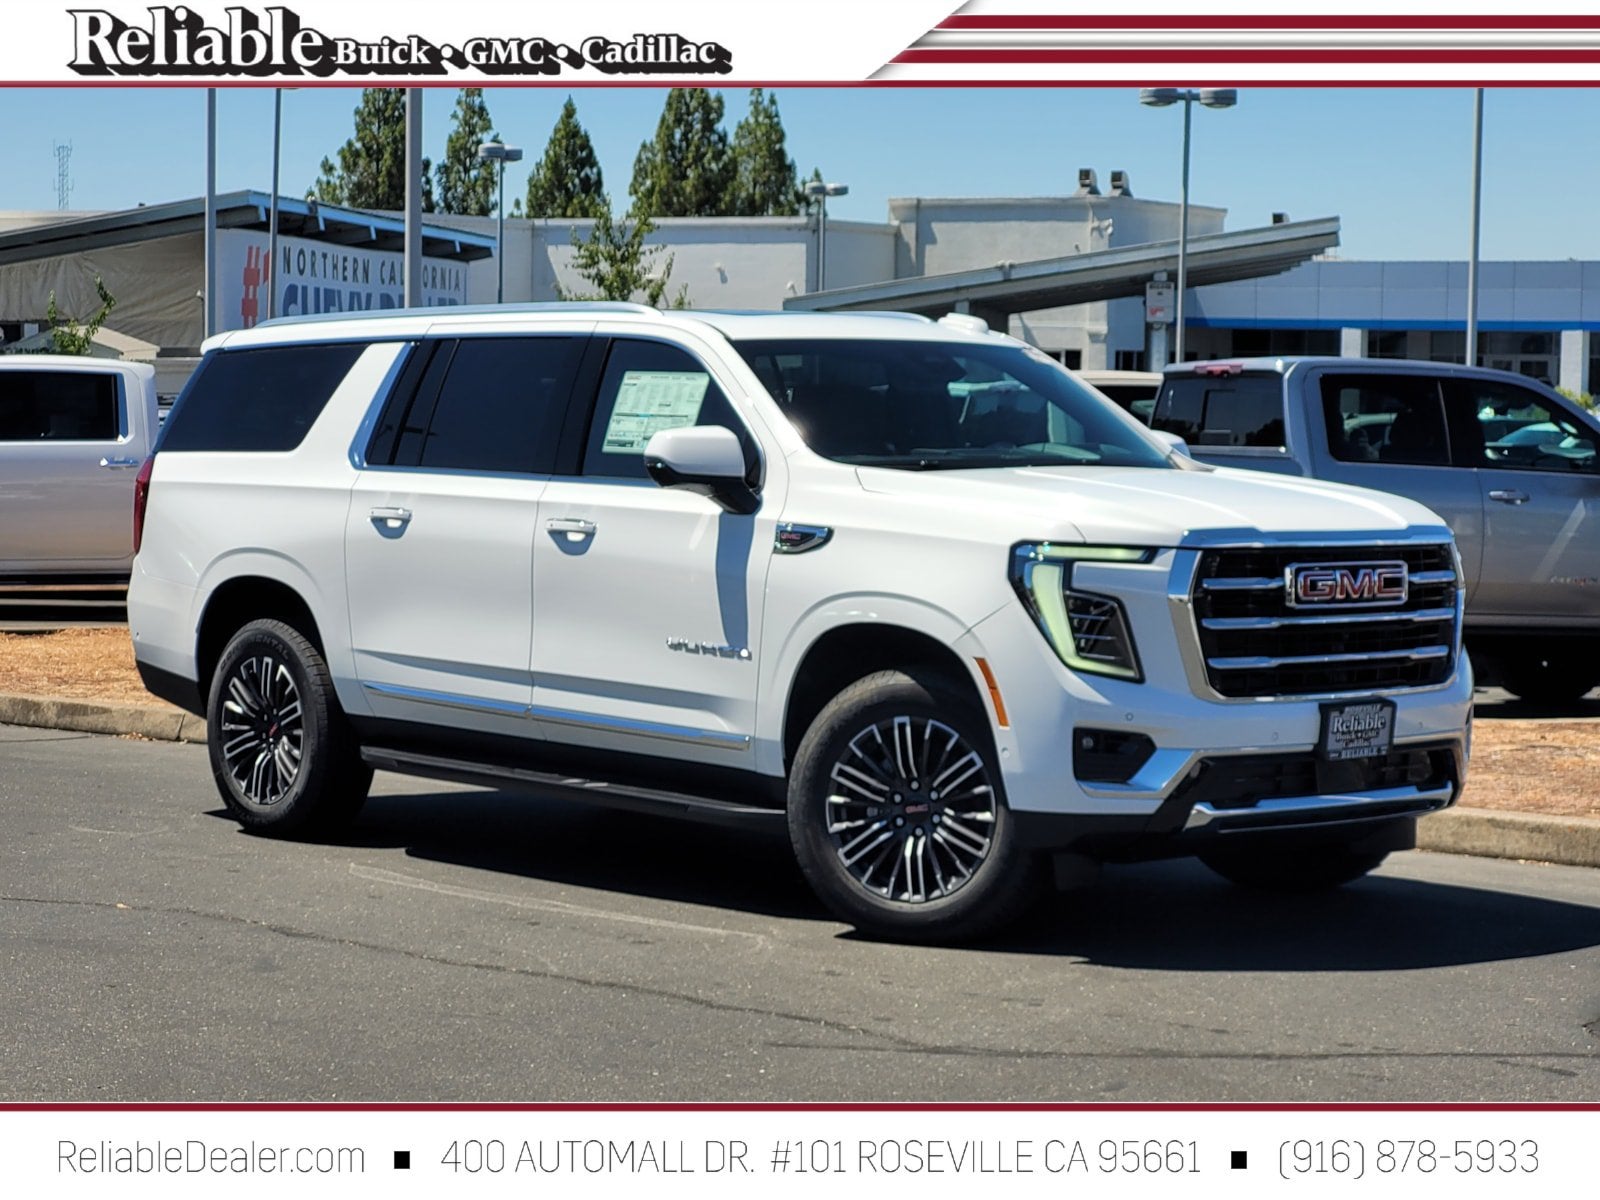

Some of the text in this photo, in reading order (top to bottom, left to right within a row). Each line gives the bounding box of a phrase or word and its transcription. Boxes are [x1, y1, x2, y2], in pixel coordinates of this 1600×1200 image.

[282, 245, 370, 285] NORTHERN
[380, 259, 460, 292] CALORNIA
[1298, 568, 1405, 600] GMC
[1332, 712, 1386, 733] Reliable
